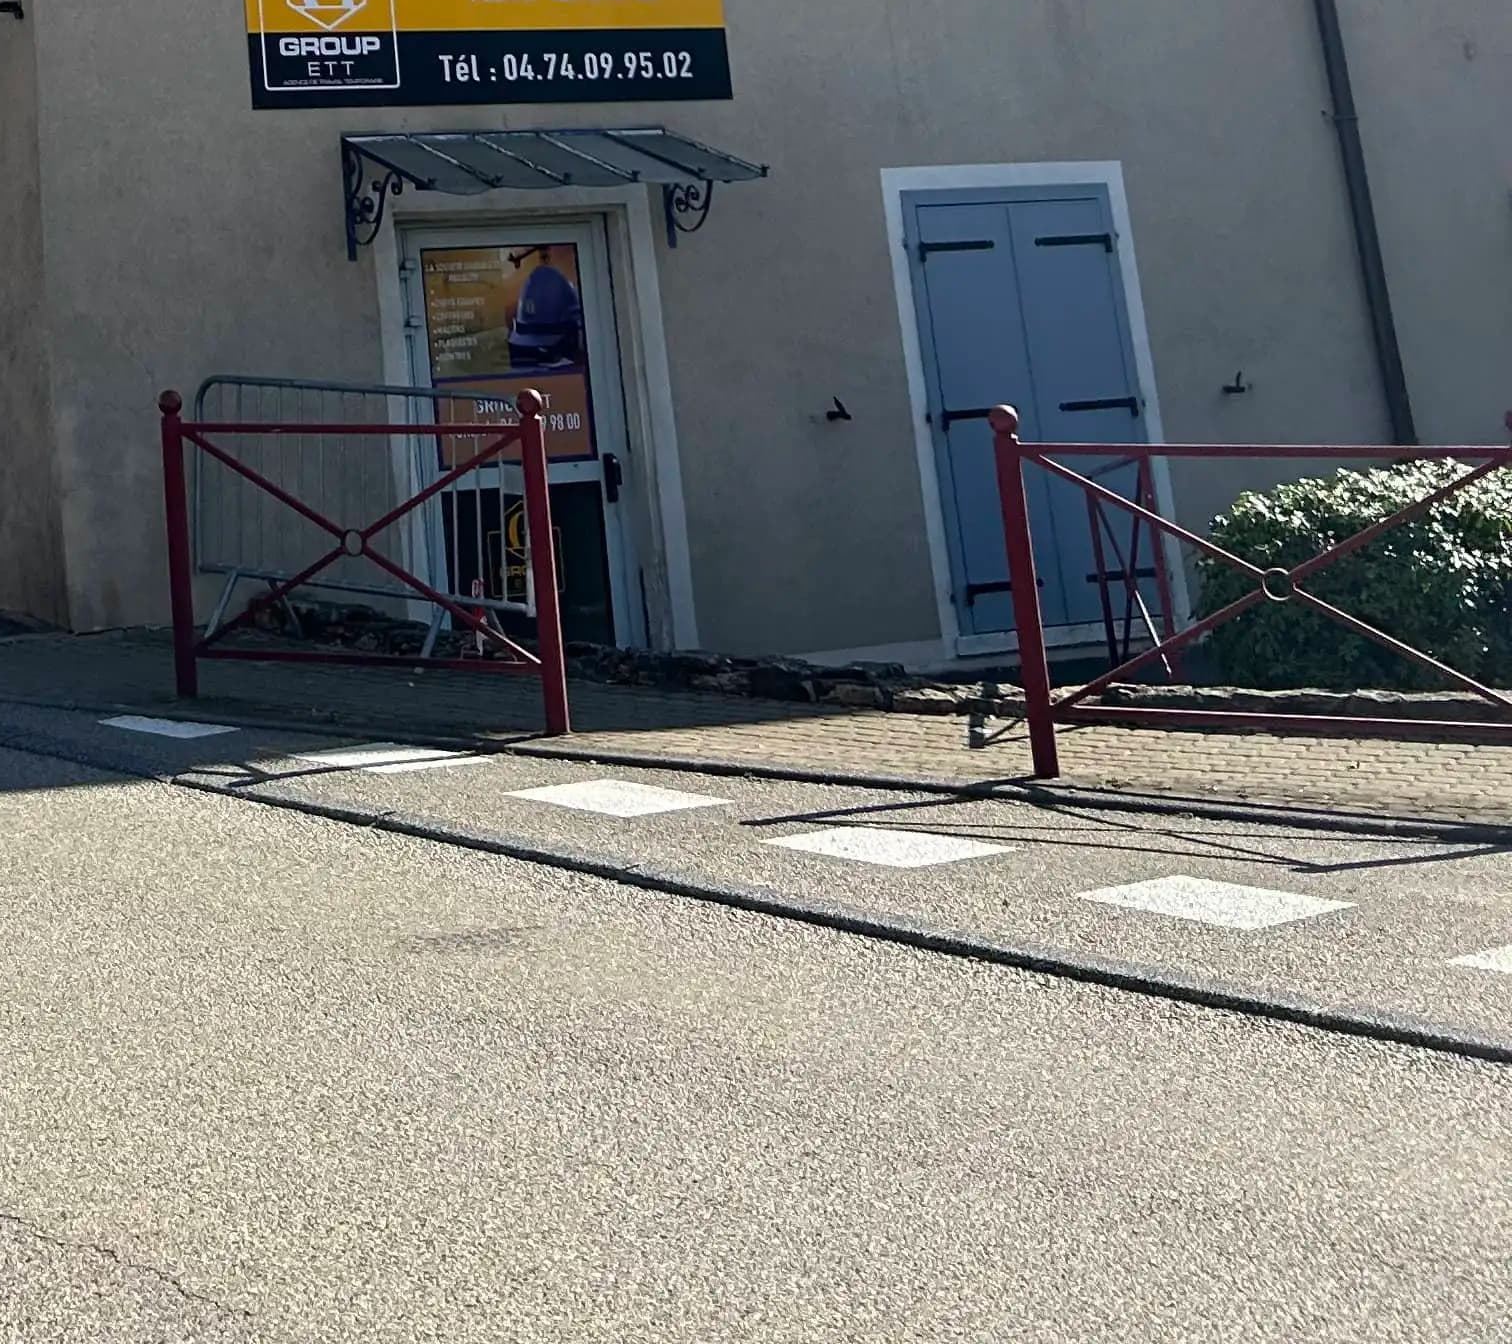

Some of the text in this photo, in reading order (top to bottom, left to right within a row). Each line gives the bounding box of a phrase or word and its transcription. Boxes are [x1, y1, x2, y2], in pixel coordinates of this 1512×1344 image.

[279, 36, 381, 56] GROUP
[307, 61, 355, 77] ETT
[438, 53, 481, 82] Tél
[502, 51, 694, 82] 04.74.09.95.02
[550, 414, 564, 431] 98
[566, 413, 581, 430] 00
